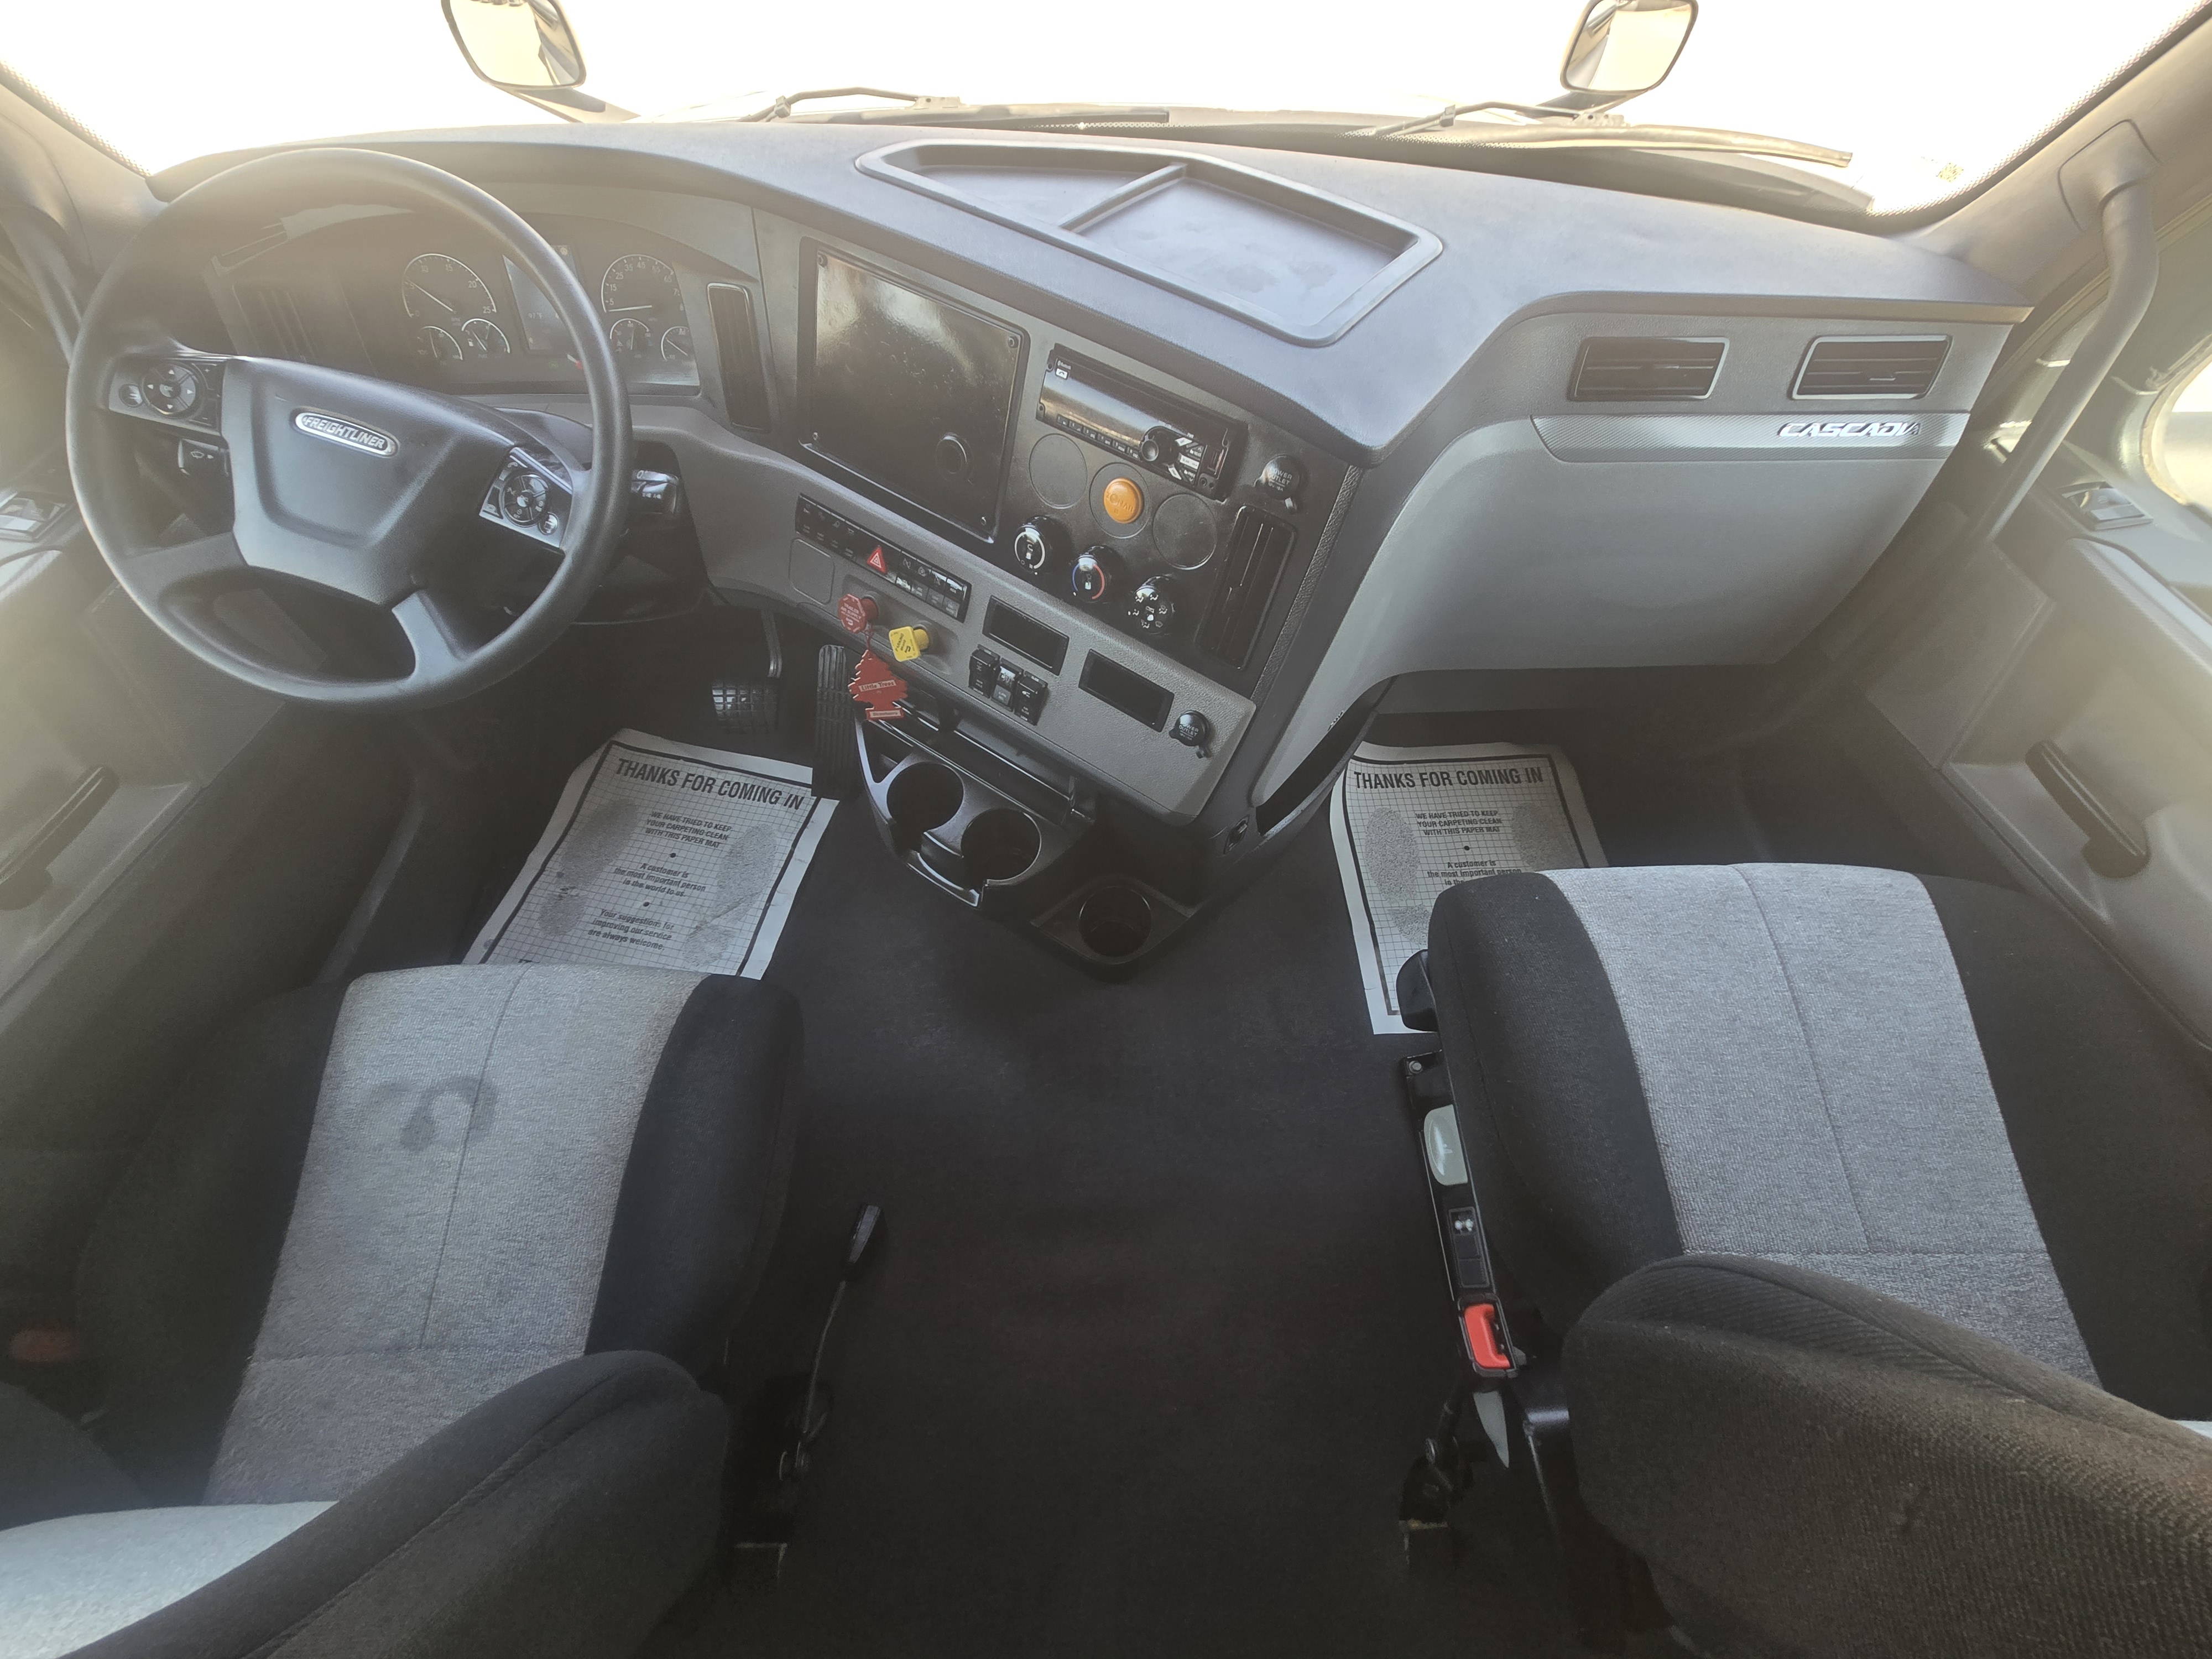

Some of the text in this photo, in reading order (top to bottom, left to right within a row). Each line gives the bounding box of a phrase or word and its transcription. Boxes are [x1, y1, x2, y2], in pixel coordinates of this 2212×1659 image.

[304, 416, 385, 449] FREIGHTLINER
[1268, 473, 1290, 485] OUTLET
[1271, 466, 1292, 480] OWER
[1179, 724, 1197, 736] OUTLET
[616, 758, 805, 810] THANKS FOR COMING IN
[1354, 766, 1544, 789] THANKS FOR COMING IN
[646, 819, 728, 841] YOUR CARPETING CLEAN
[663, 813, 682, 822] HAVE
[682, 817, 702, 826] TRIED
[714, 823, 732, 832] KEEP
[1438, 818, 1478, 827] CARPETING
[645, 827, 721, 848] WITH THIS PAPER MAT
[647, 864, 682, 877] customer
[1460, 869, 1496, 878] important
[627, 870, 645, 879] most
[645, 874, 681, 887] important
[680, 881, 706, 892] person
[632, 880, 644, 888] the
[645, 884, 666, 893] world
[592, 918, 630, 933] improving
[644, 929, 672, 941] service
[600, 909, 675, 930] Your suggestions for
[602, 931, 629, 943] always
[629, 937, 665, 951] welcome.
